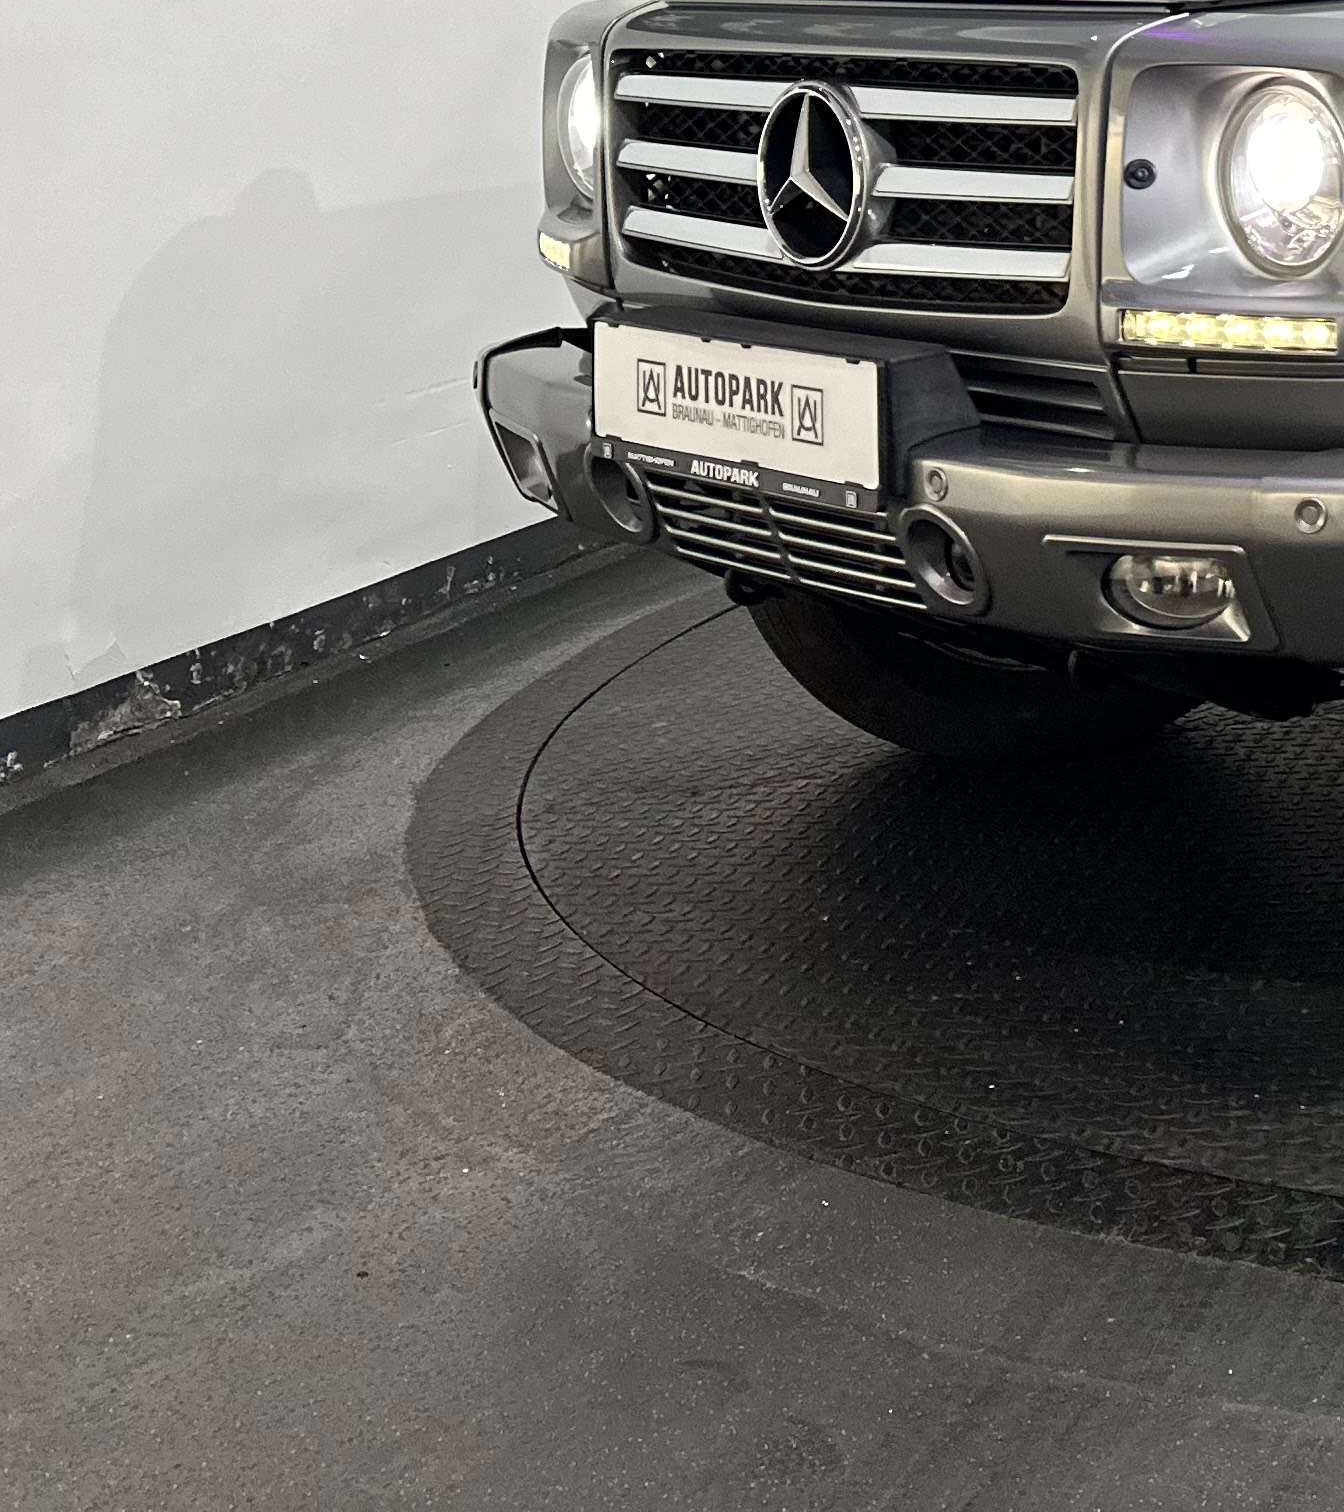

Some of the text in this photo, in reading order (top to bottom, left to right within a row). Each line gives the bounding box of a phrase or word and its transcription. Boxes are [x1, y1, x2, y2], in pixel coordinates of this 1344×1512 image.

[672, 365, 784, 417] AUTOPARK
[672, 403, 714, 426] BRAUNAU
[690, 460, 759, 487] AUTOPARK
